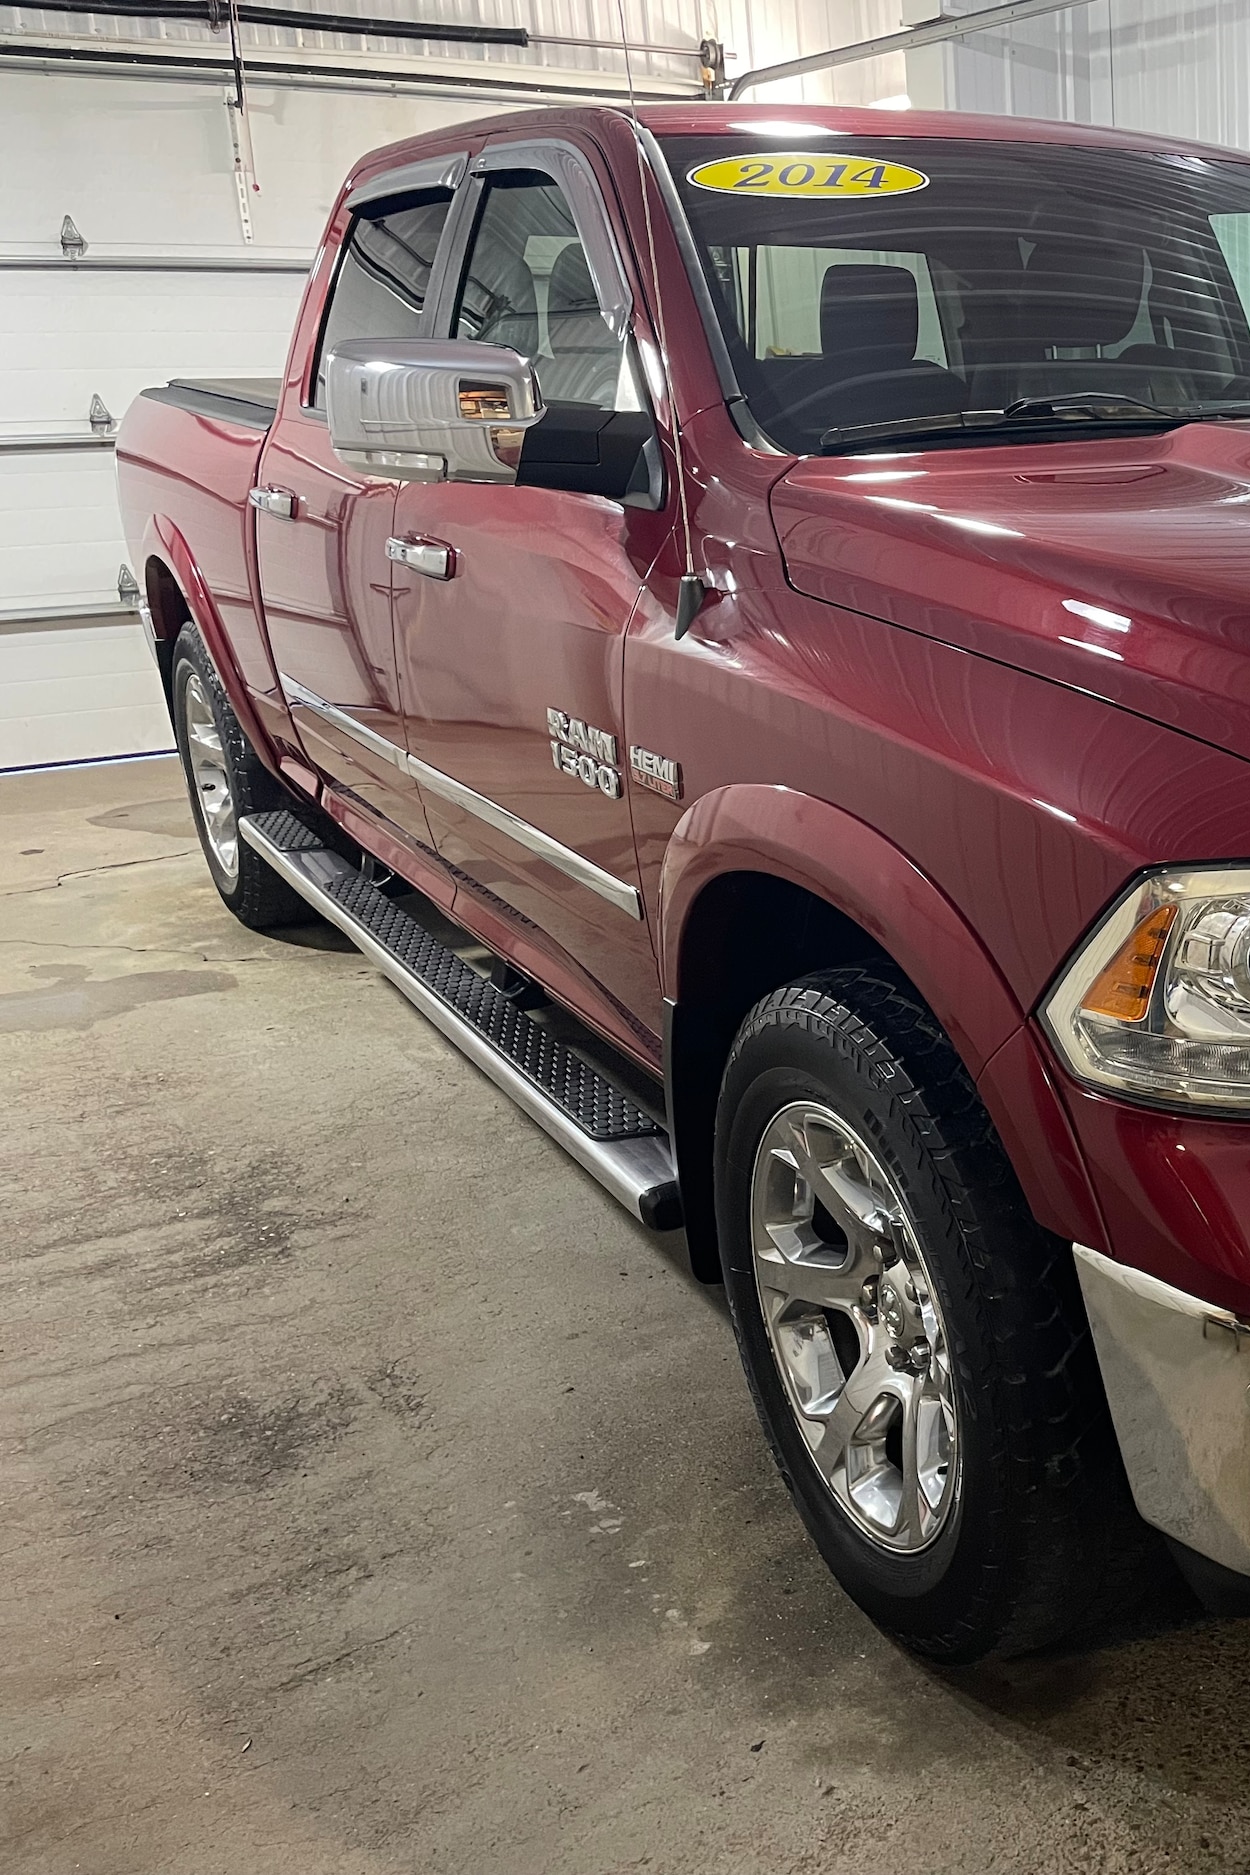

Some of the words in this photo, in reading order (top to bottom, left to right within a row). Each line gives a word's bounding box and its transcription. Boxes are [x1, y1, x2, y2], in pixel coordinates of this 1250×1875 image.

[732, 163, 890, 189] 2014
[547, 707, 619, 766] RAM
[550, 740, 624, 800] 1500
[630, 745, 677, 784] HEMI
